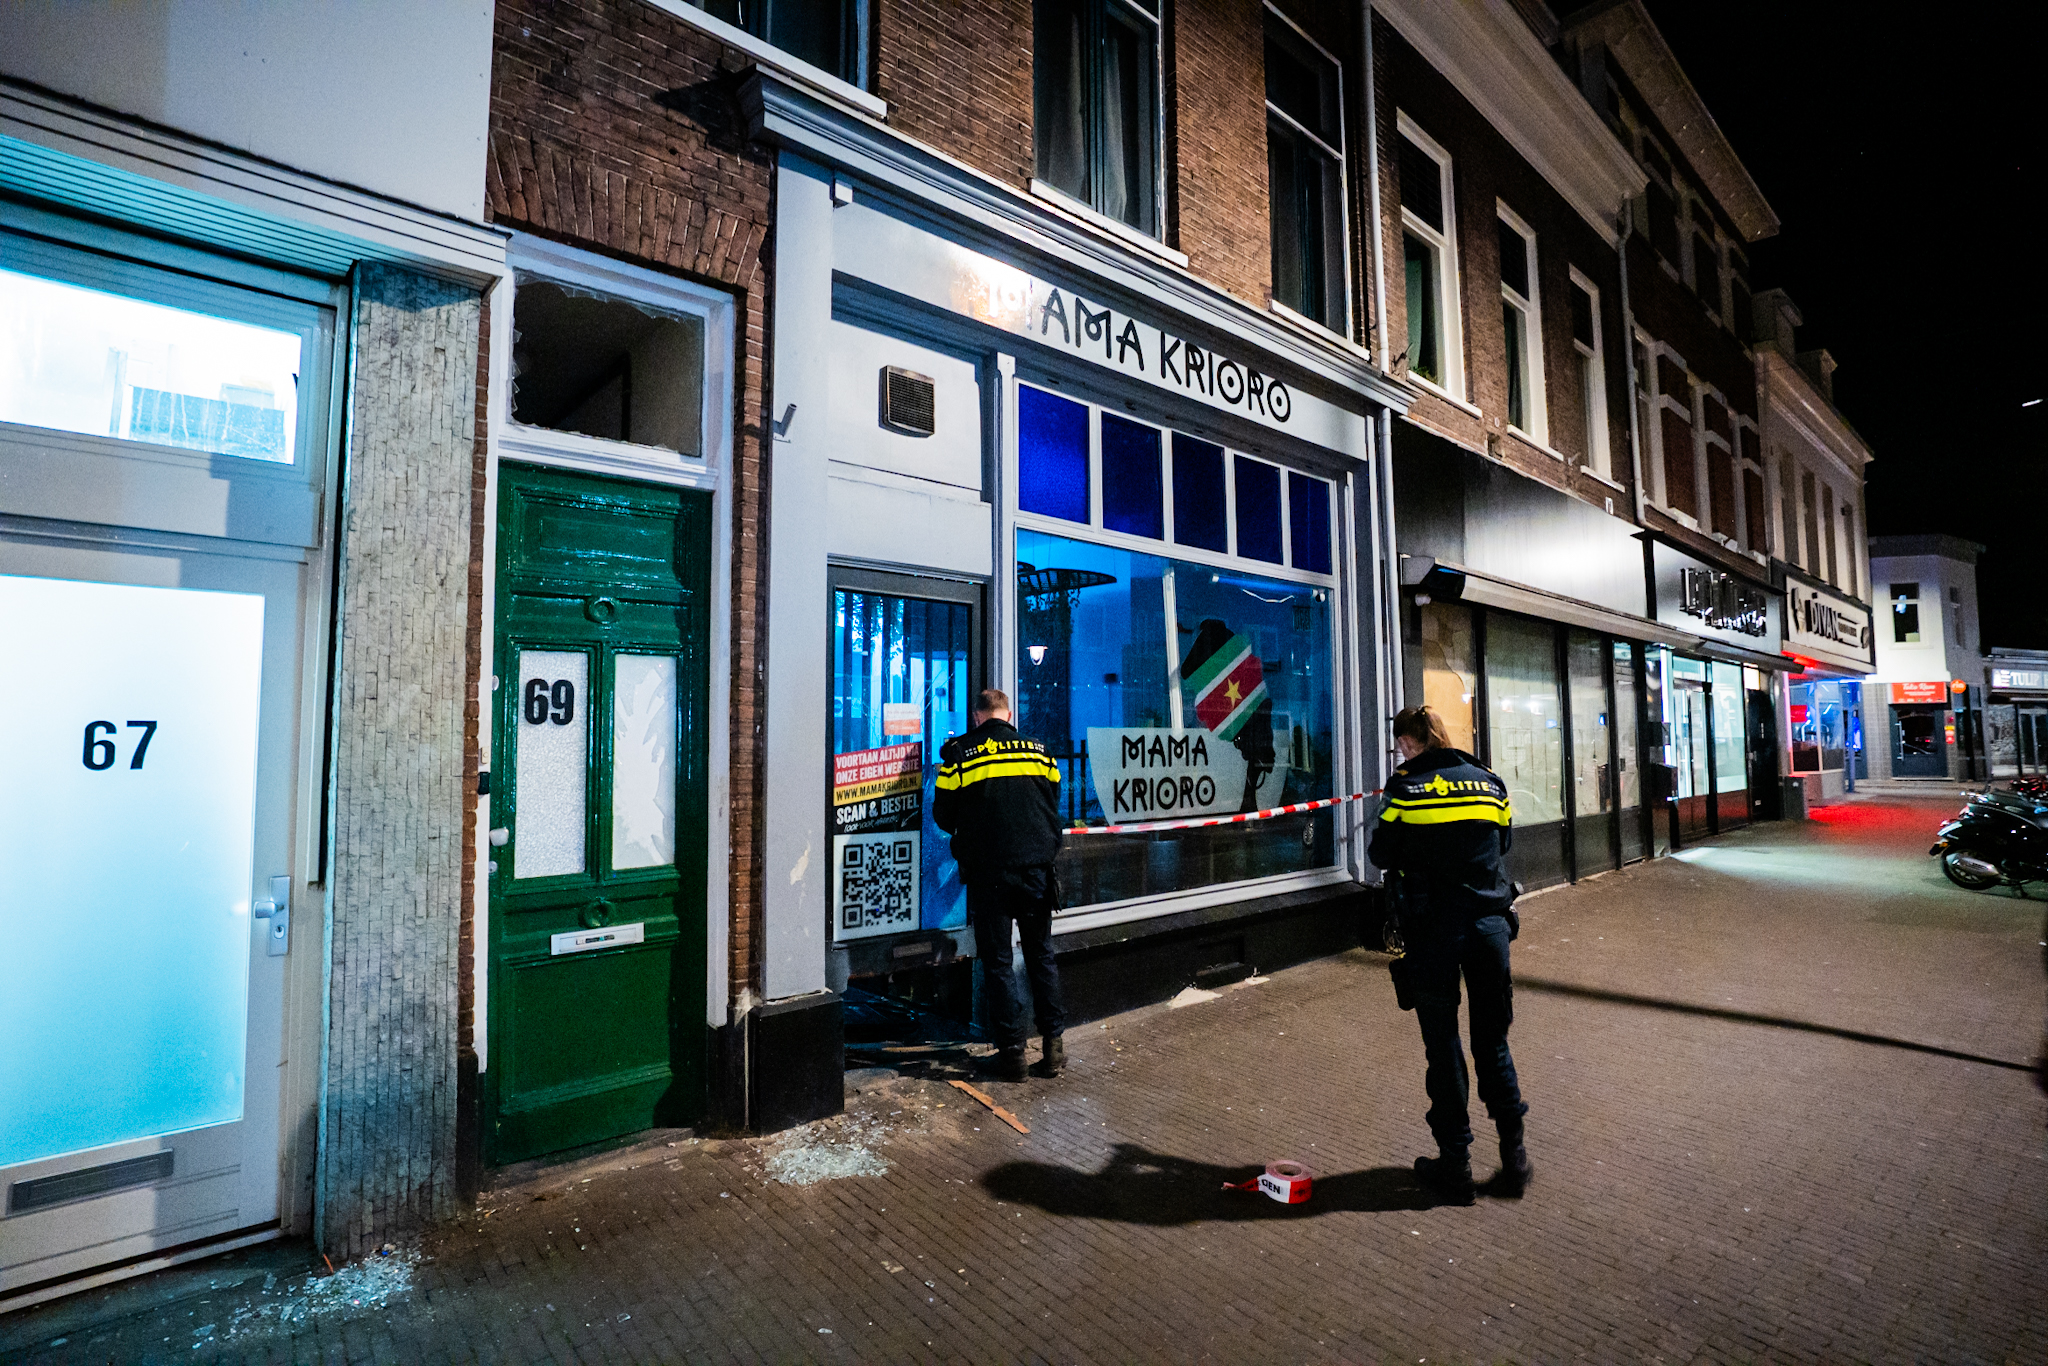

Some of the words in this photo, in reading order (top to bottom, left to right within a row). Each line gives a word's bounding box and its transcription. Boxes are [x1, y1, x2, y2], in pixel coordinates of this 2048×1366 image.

[1160, 331, 1291, 423] KRIORO
[2010, 671, 2040, 686] TULIP
[525, 678, 574, 725] 69
[82, 720, 157, 770] 67
[836, 751, 878, 769] VOORTAAN
[879, 746, 905, 762] ALTIJD
[906, 744, 919, 757] VIA
[977, 738, 1036, 754] POLITIE
[1121, 734, 1208, 769] MAMA
[836, 768, 858, 784] ONZE
[860, 765, 884, 780] EIGEN
[884, 758, 919, 776] WEBSITE
[1424, 776, 1490, 796] POLITIE
[836, 802, 867, 825] SCAN
[869, 801, 878, 817] &
[881, 793, 919, 815] BESTEL
[1114, 775, 1216, 813] KRIORO
